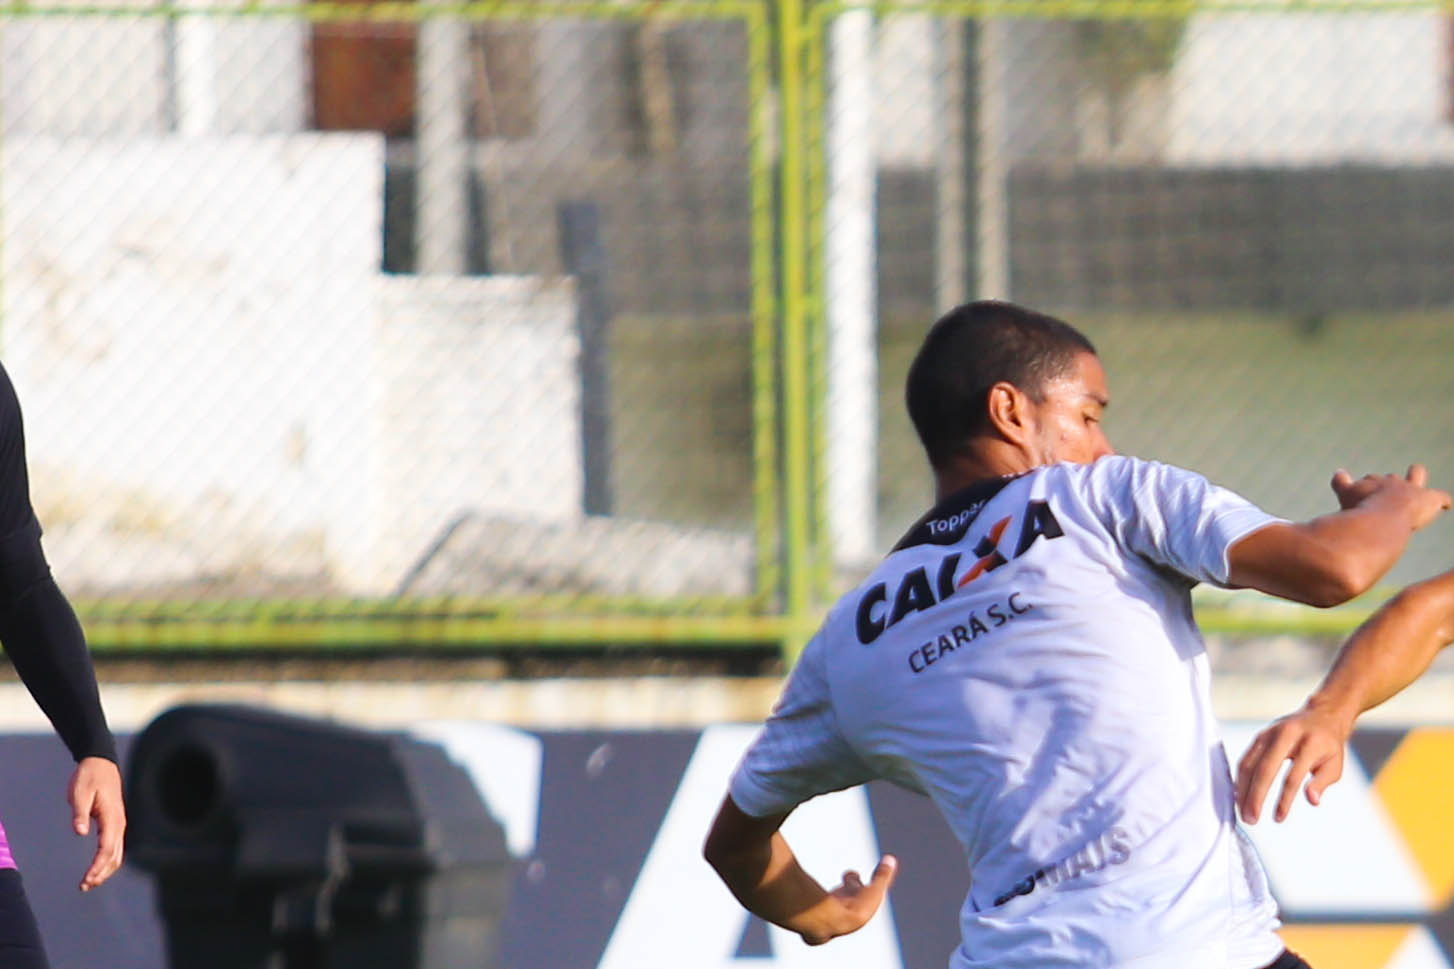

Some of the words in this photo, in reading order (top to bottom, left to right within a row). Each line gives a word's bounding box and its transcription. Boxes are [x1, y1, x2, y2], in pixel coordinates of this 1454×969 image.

[856, 498, 1065, 645] CAIXA
[908, 611, 988, 673] CEARÁ
[987, 592, 1032, 628] S.C.
